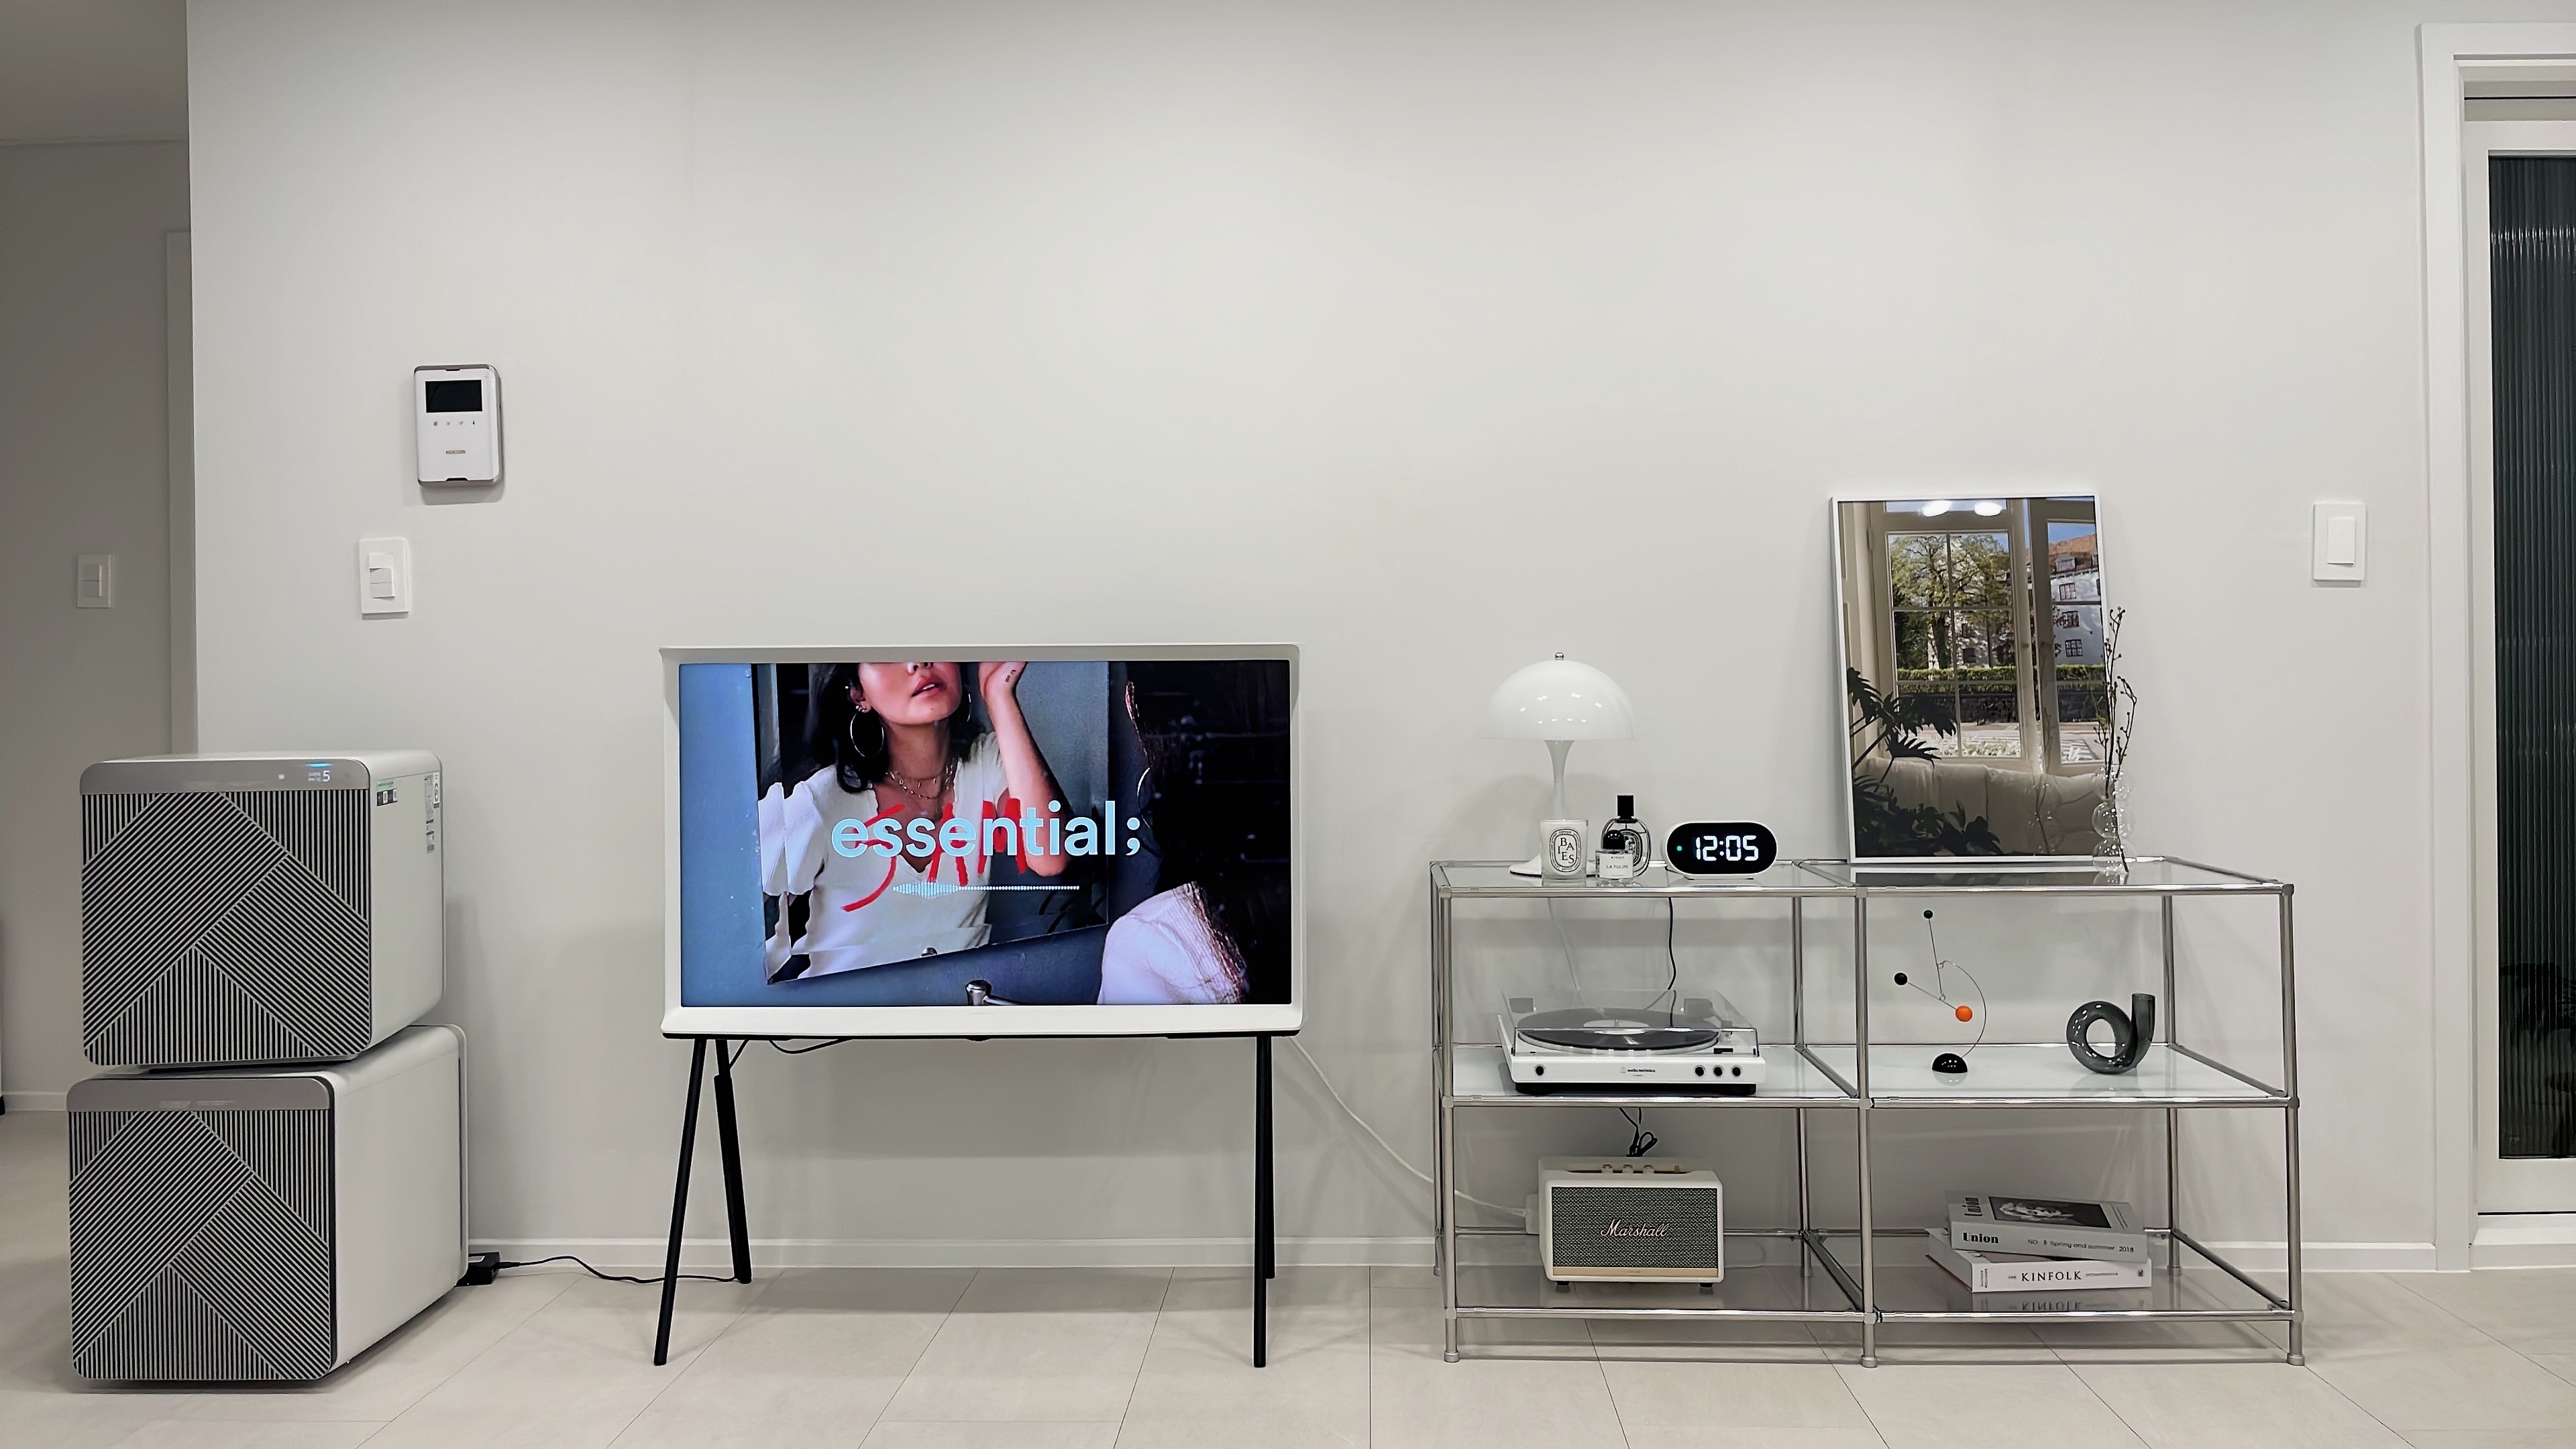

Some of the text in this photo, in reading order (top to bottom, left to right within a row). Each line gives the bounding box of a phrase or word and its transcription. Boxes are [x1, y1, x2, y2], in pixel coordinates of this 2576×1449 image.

[323, 770, 331, 782] 5
[831, 800, 1141, 857] essential;
[1695, 835, 1759, 861] 12:05
[1600, 1218, 1670, 1237] Marshall
[1963, 1232, 1999, 1244] Union
[2021, 1271, 2082, 1281] KINFOLK
